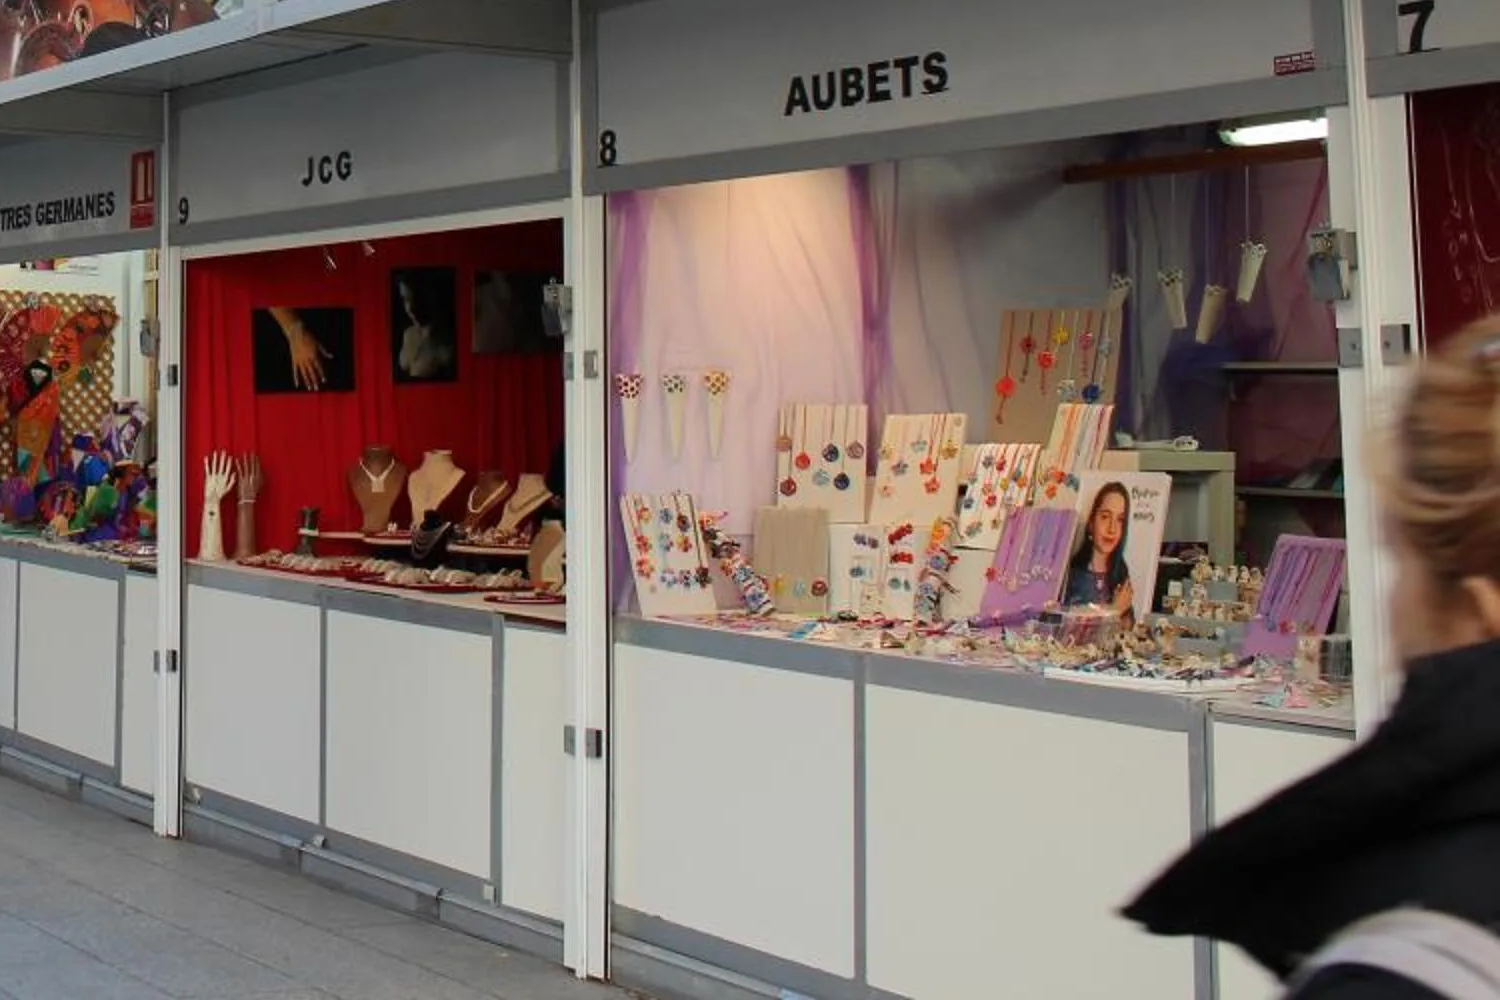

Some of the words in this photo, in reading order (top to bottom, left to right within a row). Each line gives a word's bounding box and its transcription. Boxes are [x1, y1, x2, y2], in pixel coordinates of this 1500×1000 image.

[783, 51, 948, 117] AUBETS
[599, 129, 618, 167] 8
[301, 150, 352, 187] JCG
[0, 203, 32, 231] TRES
[35, 191, 116, 225] GERMANES
[178, 197, 189, 225] 9
